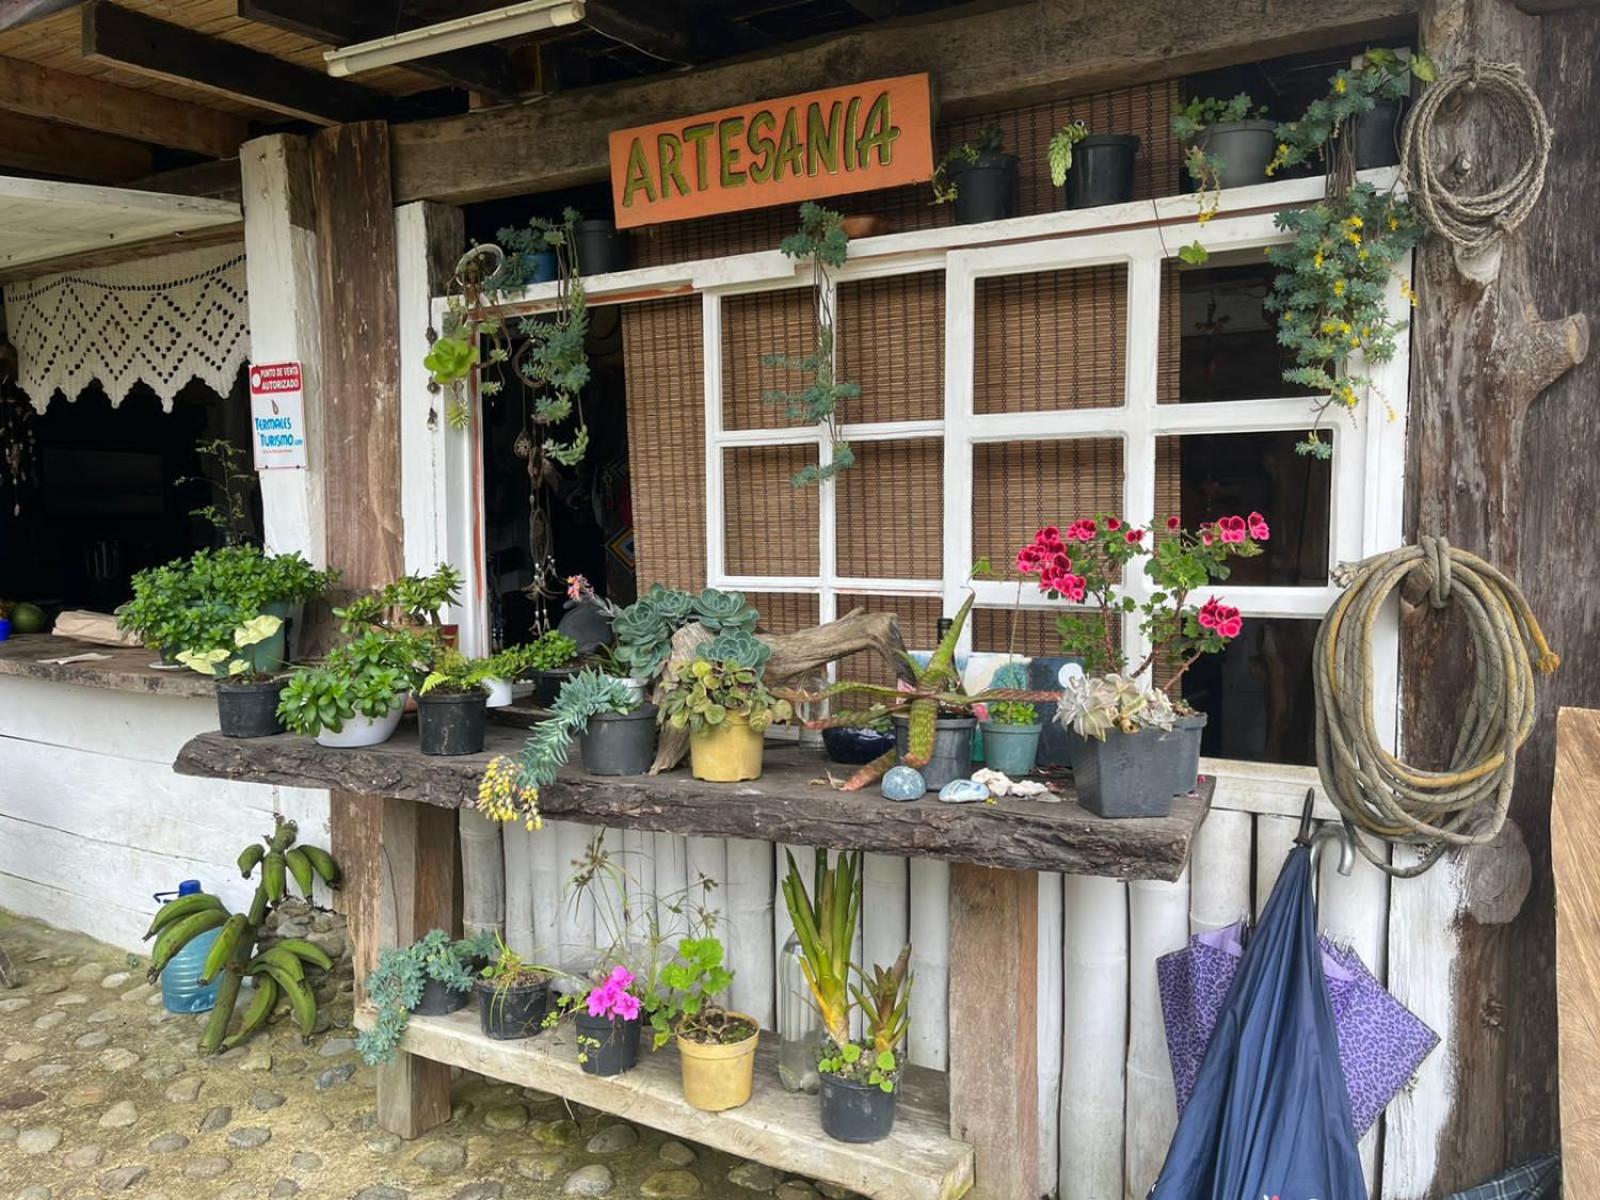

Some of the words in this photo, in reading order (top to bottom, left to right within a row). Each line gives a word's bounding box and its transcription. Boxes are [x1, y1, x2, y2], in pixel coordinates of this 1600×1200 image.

[622, 91, 901, 208] ARTESANIA
[260, 368, 275, 377] PUNTO
[276, 367, 283, 376] DE
[284, 366, 299, 375] VENTA
[262, 379, 299, 389] AUTORIZADO
[255, 417, 292, 431] TERMALES
